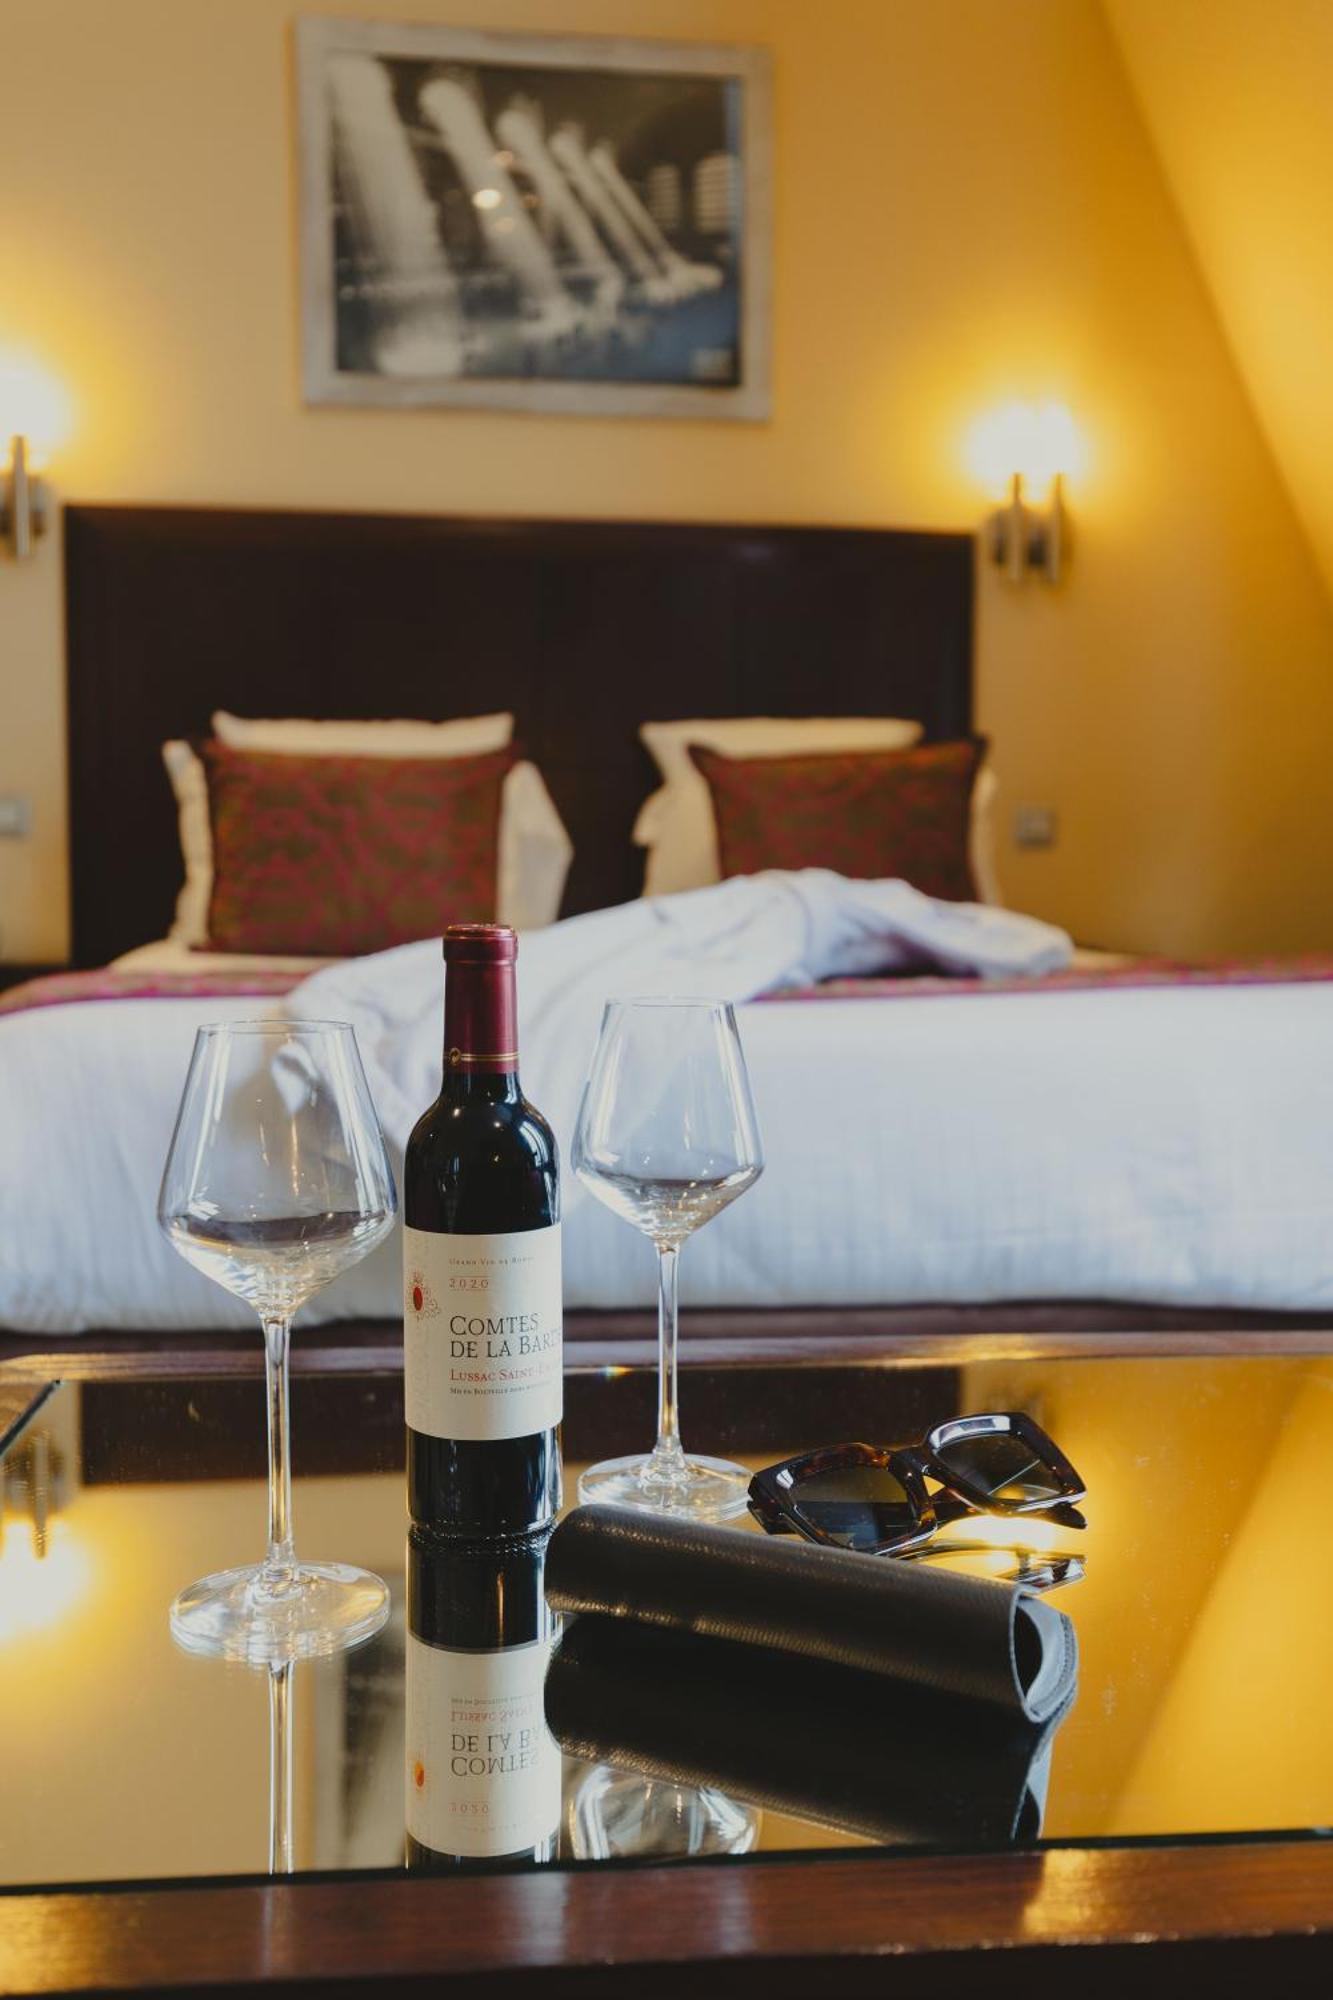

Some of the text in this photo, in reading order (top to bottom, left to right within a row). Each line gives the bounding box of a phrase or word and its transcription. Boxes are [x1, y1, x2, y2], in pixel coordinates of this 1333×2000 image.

[449, 1278, 489, 1289] 2020
[450, 1312, 539, 1336] COMTES
[451, 1340, 478, 1358] DE
[487, 1339, 512, 1358] LA
[451, 1368, 497, 1383] LUSSAC
